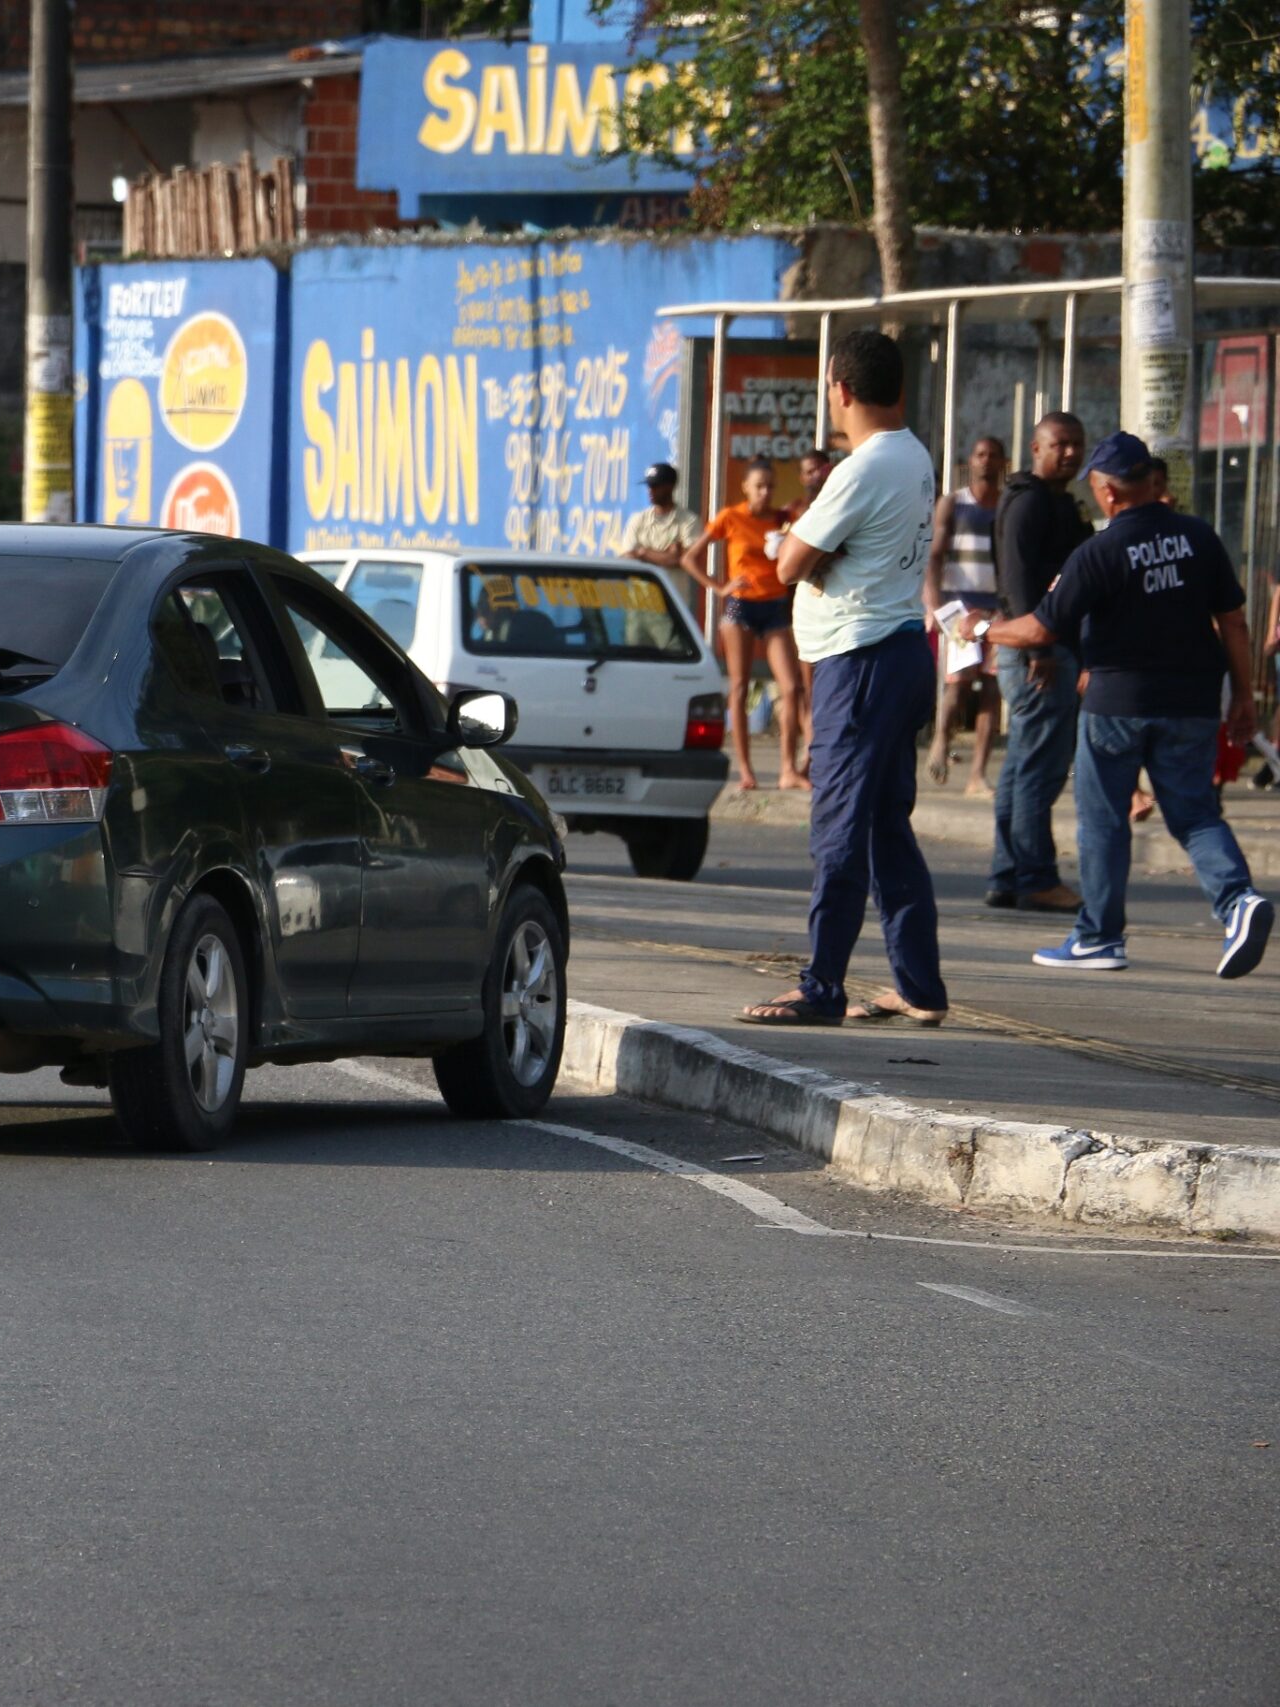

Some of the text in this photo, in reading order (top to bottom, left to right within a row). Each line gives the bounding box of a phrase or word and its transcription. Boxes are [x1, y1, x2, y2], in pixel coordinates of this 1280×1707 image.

[724, 391, 818, 415] ATACA
[1126, 532, 1193, 570] POLÍCIA
[1143, 563, 1185, 594] CIVIL
